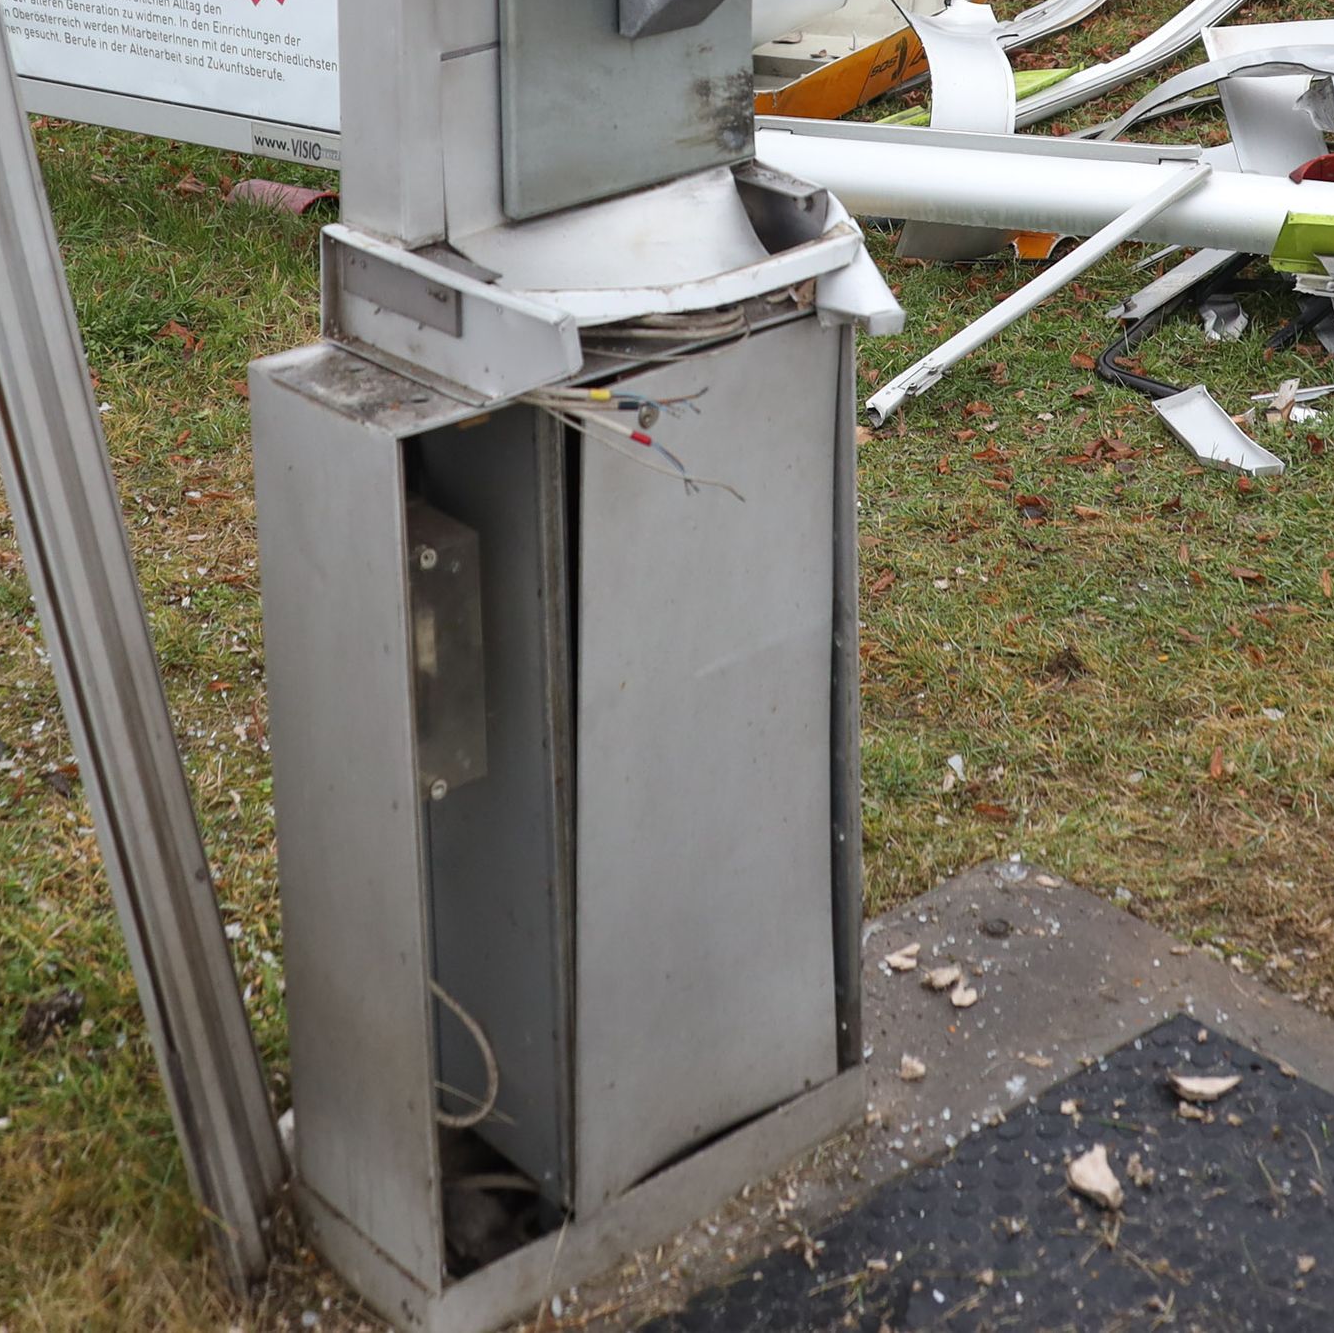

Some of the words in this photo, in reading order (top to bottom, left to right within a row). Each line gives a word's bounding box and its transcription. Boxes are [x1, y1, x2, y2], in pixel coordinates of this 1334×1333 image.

[122, 8, 134, 20] zu
[135, 10, 177, 26] widmen.
[179, 15, 189, 29] In
[191, 17, 210, 32] den
[213, 20, 282, 45] Einrichtungen
[284, 33, 302, 48] der
[203, 0, 222, 16] den
[24, 26, 62, 44] gesucht.
[64, 31, 97, 49] Berufe
[99, 38, 109, 52] in
[111, 40, 127, 54] der
[129, 43, 182, 65] Altenarbeit
[184, 53, 205, 68] sind
[207, 55, 286, 82] Zukunftsberufe.
[83, 18, 119, 35] werden
[121, 23, 199, 48] MitarbeiterInnen
[201, 38, 218, 52] mit
[220, 41, 238, 56] den
[240, 47, 338, 73] unterschiedlichsten
